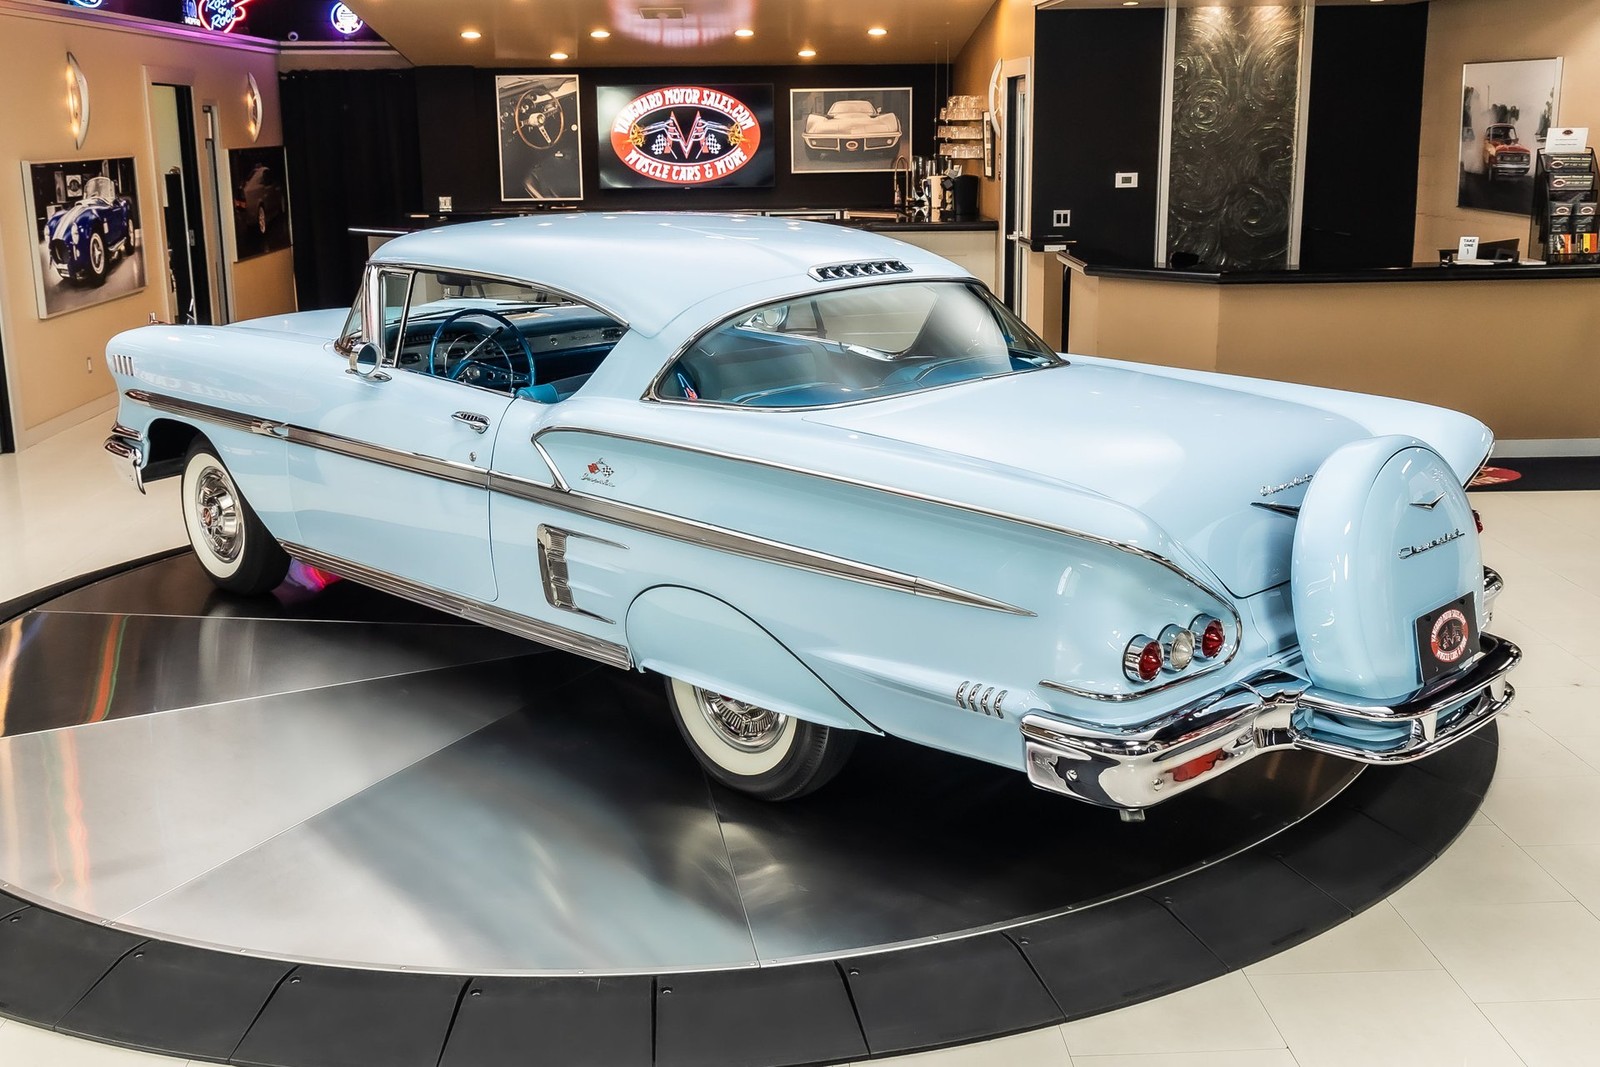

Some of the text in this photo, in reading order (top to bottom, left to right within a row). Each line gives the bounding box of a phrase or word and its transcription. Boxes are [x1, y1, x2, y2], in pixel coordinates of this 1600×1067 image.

[614, 88, 756, 134] VANGUARD MOTOR SALES.COM
[624, 147, 748, 181] MUSCLE CARS & MORE
